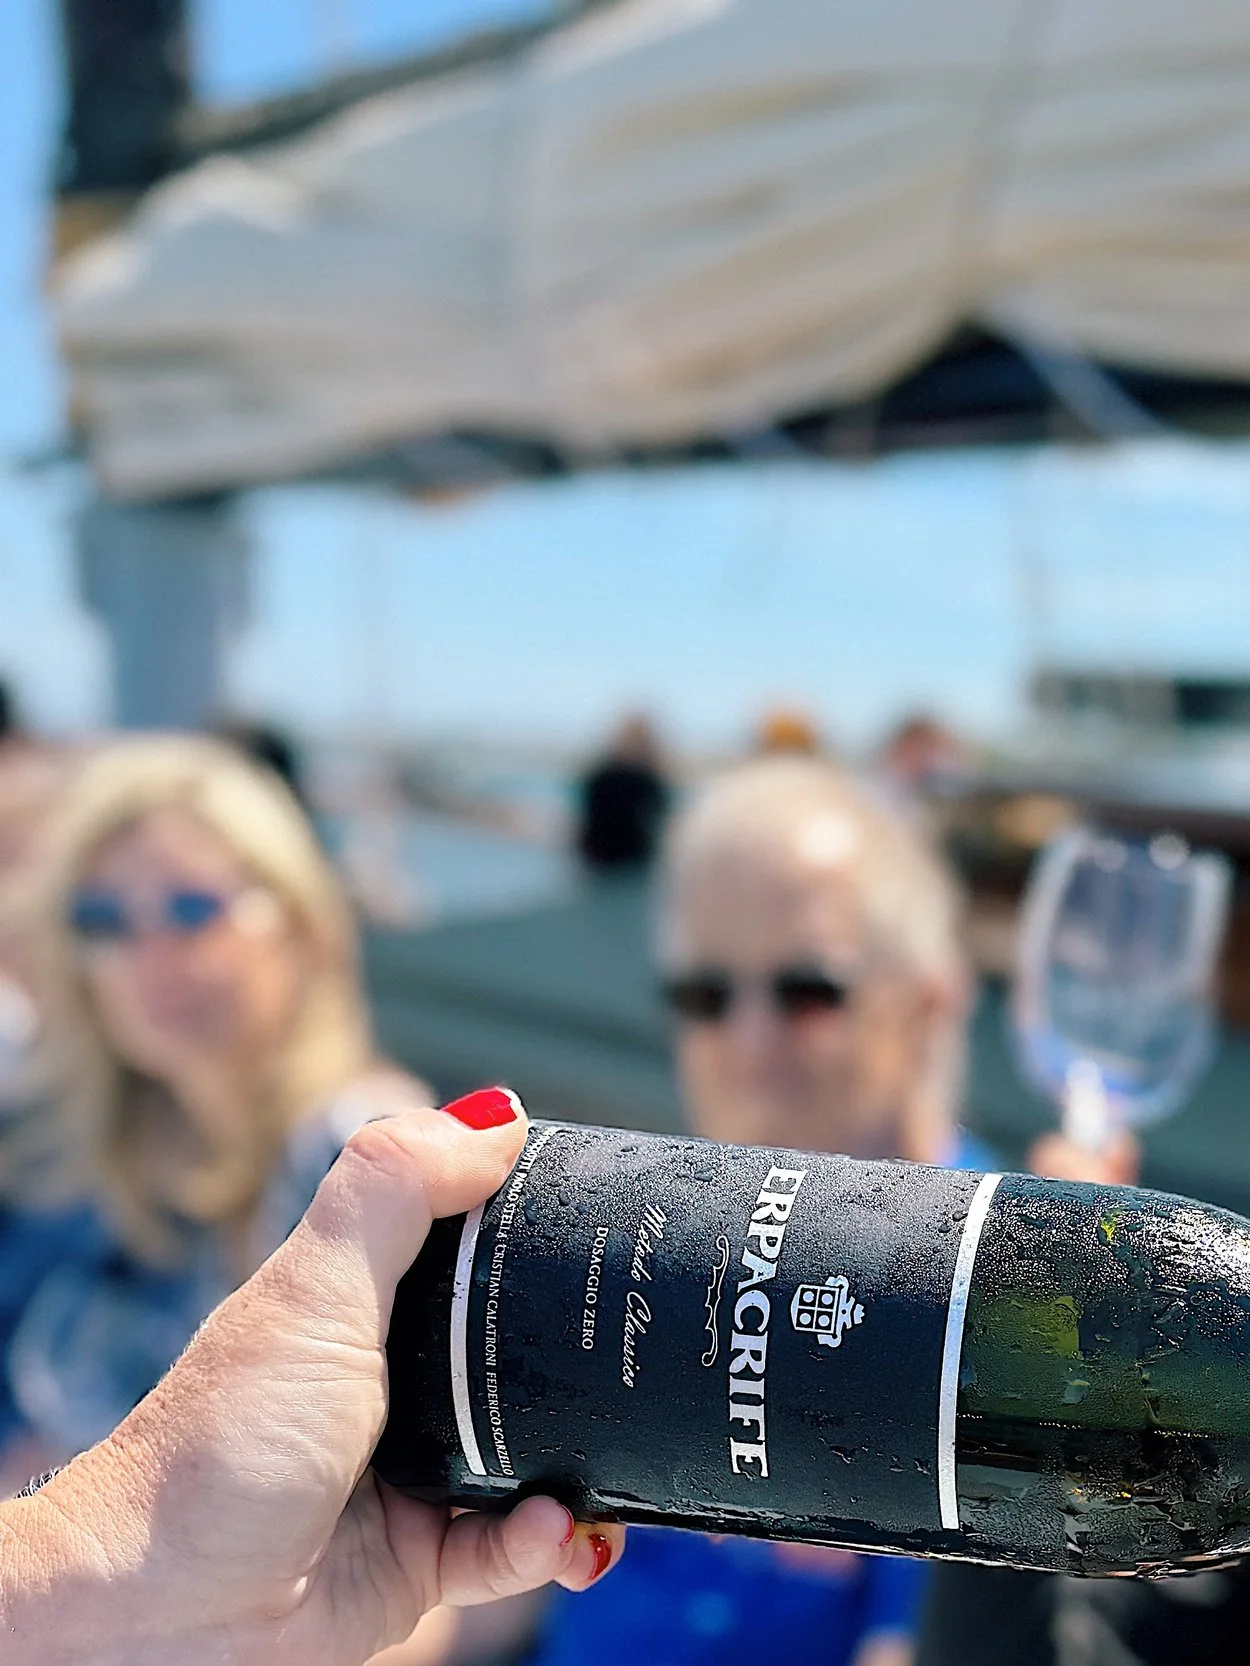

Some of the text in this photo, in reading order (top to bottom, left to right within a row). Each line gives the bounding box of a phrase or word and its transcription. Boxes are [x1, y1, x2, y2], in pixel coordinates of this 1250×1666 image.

[507, 1171, 527, 1201] PAOLO
[496, 1202, 516, 1238] STELLA
[489, 1244, 506, 1297] CRISTIAN
[582, 1226, 609, 1350] DOSAGGIO ZERO
[622, 1203, 667, 1388] Metodo Classico
[485, 1299, 498, 1366] CALATRONI
[729, 1166, 808, 1477] ERPACRIFE
[486, 1372, 501, 1425] FEDERICO
[492, 1426, 514, 1476] SCARZELLO
